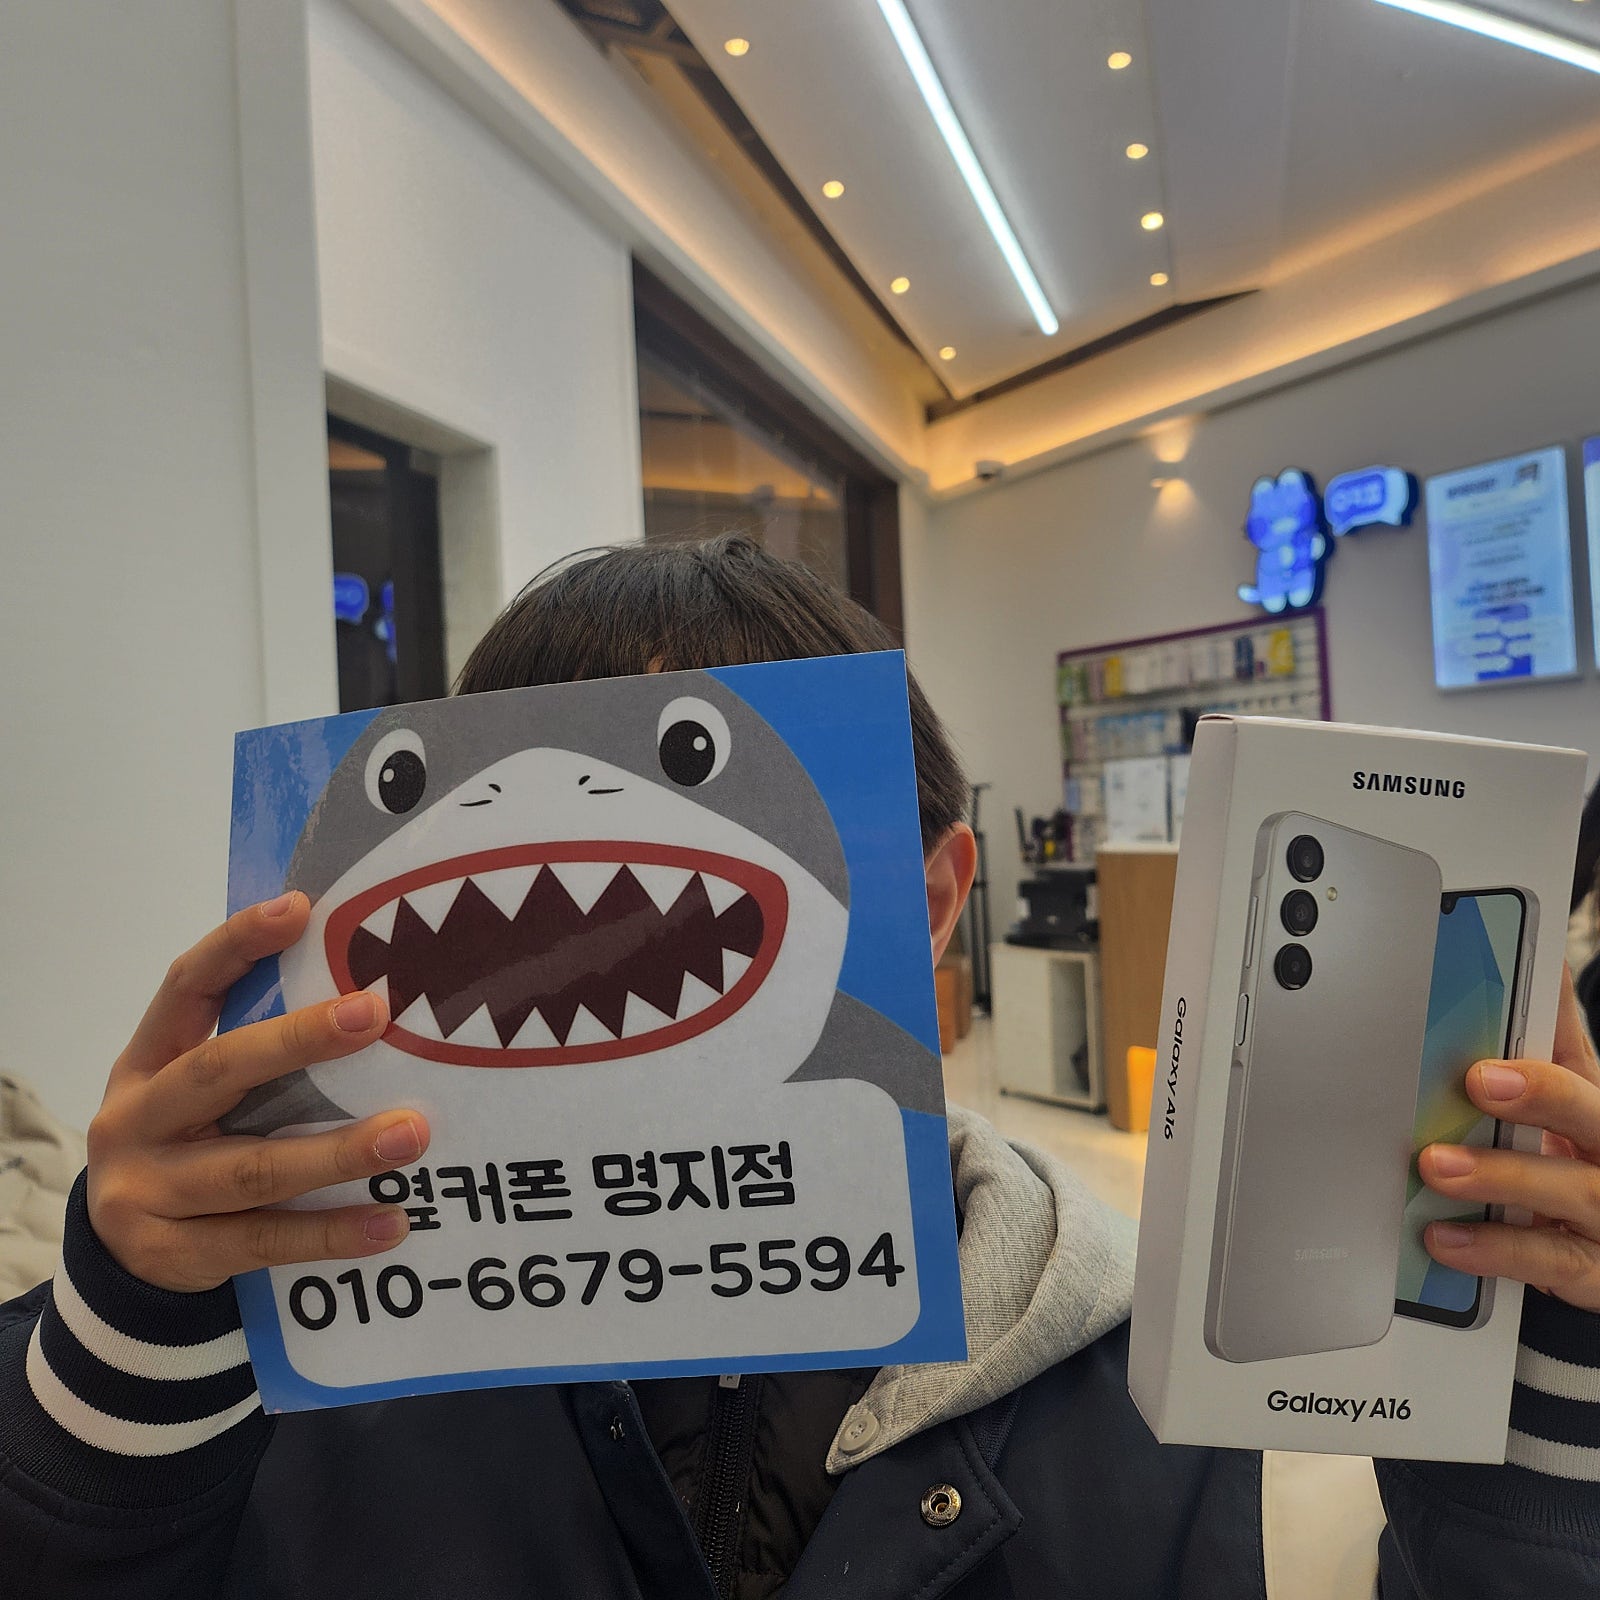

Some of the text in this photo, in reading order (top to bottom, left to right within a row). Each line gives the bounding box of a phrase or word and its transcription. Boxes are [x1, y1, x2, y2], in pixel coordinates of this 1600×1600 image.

[1353, 771, 1465, 798] SAMSUNG
[1164, 997, 1187, 1140] Galaxy A16
[369, 1141, 796, 1231] 옆커폰 명지점
[289, 1232, 905, 1331] 010-6679-5594
[1267, 1390, 1411, 1422] Galaxy A16
